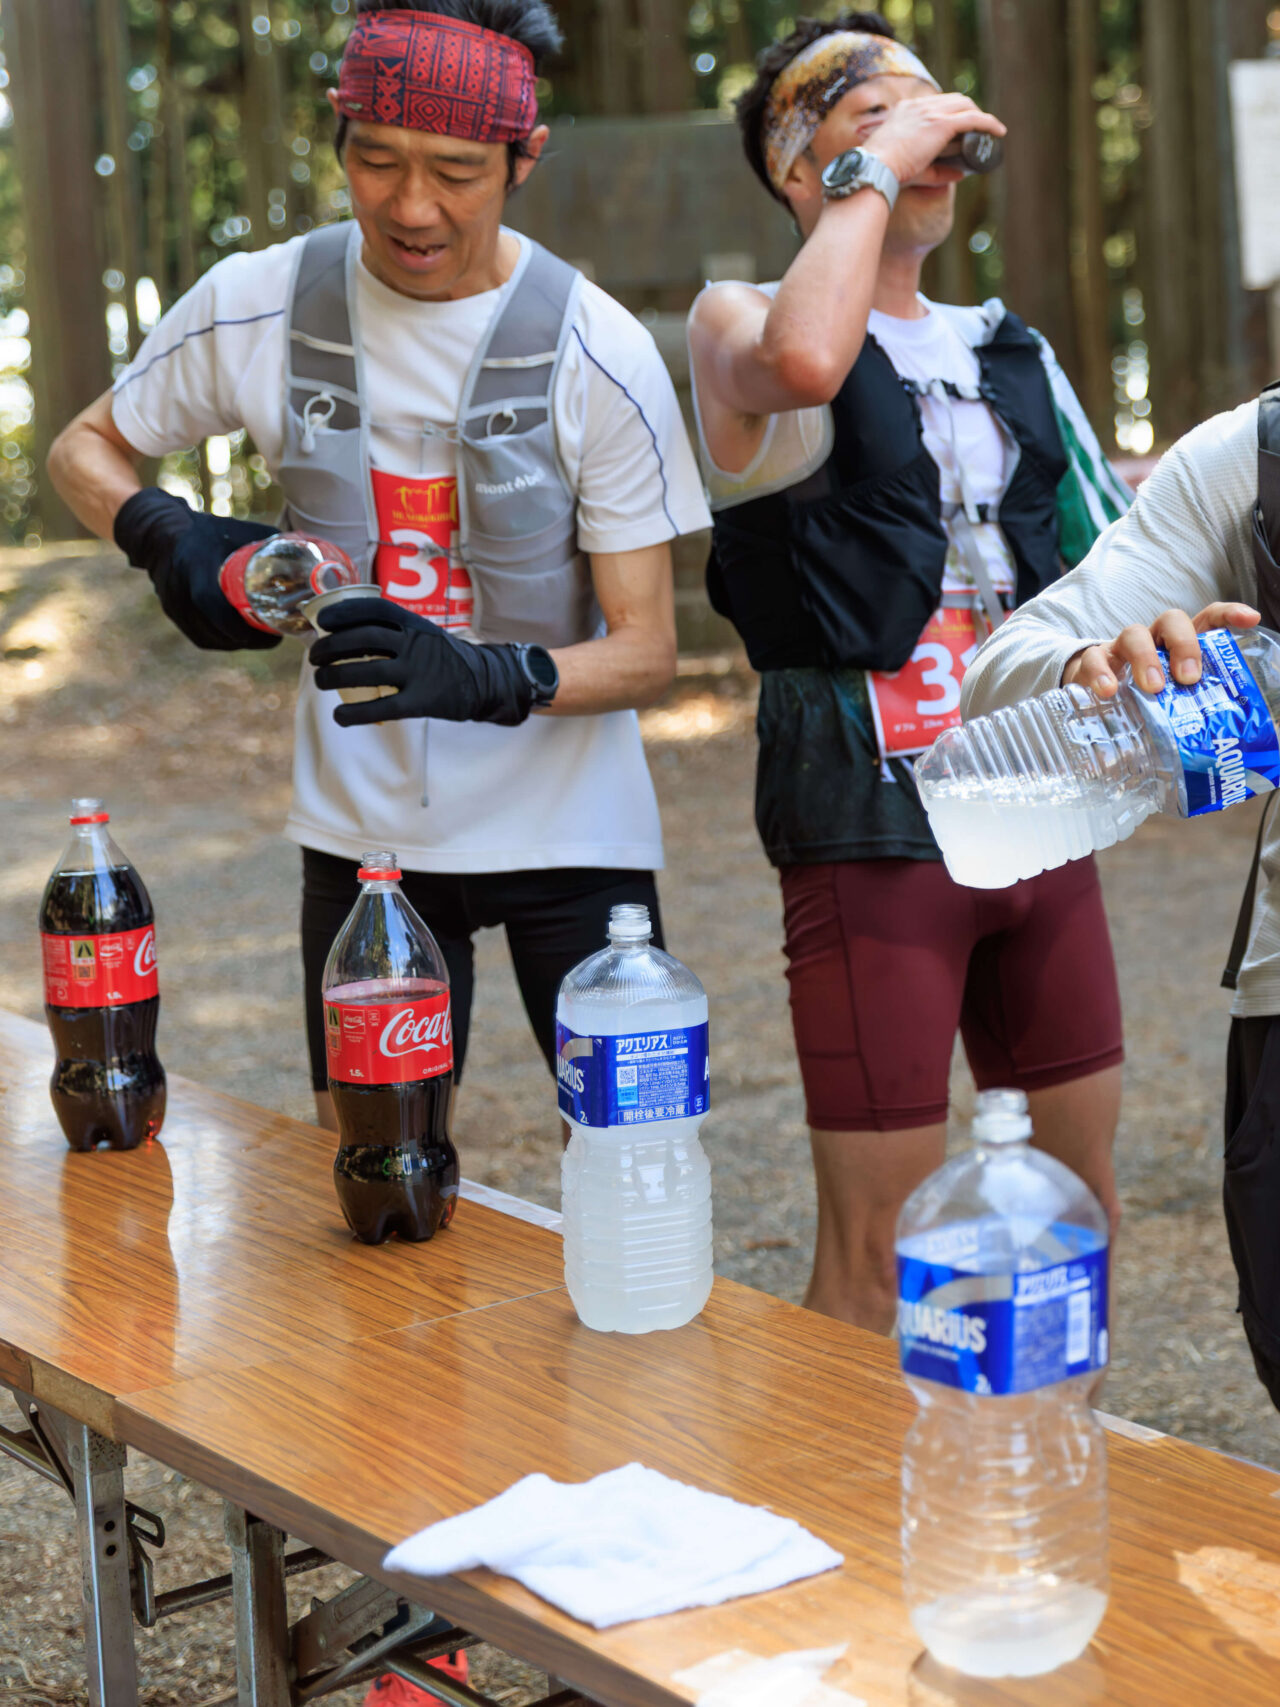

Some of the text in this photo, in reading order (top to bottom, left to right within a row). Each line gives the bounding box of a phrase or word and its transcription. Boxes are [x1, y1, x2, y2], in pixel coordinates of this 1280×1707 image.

[616, 1034, 668, 1054] アクエリアス
[623, 1104, 686, 1122] 開栓後要冷蔵
